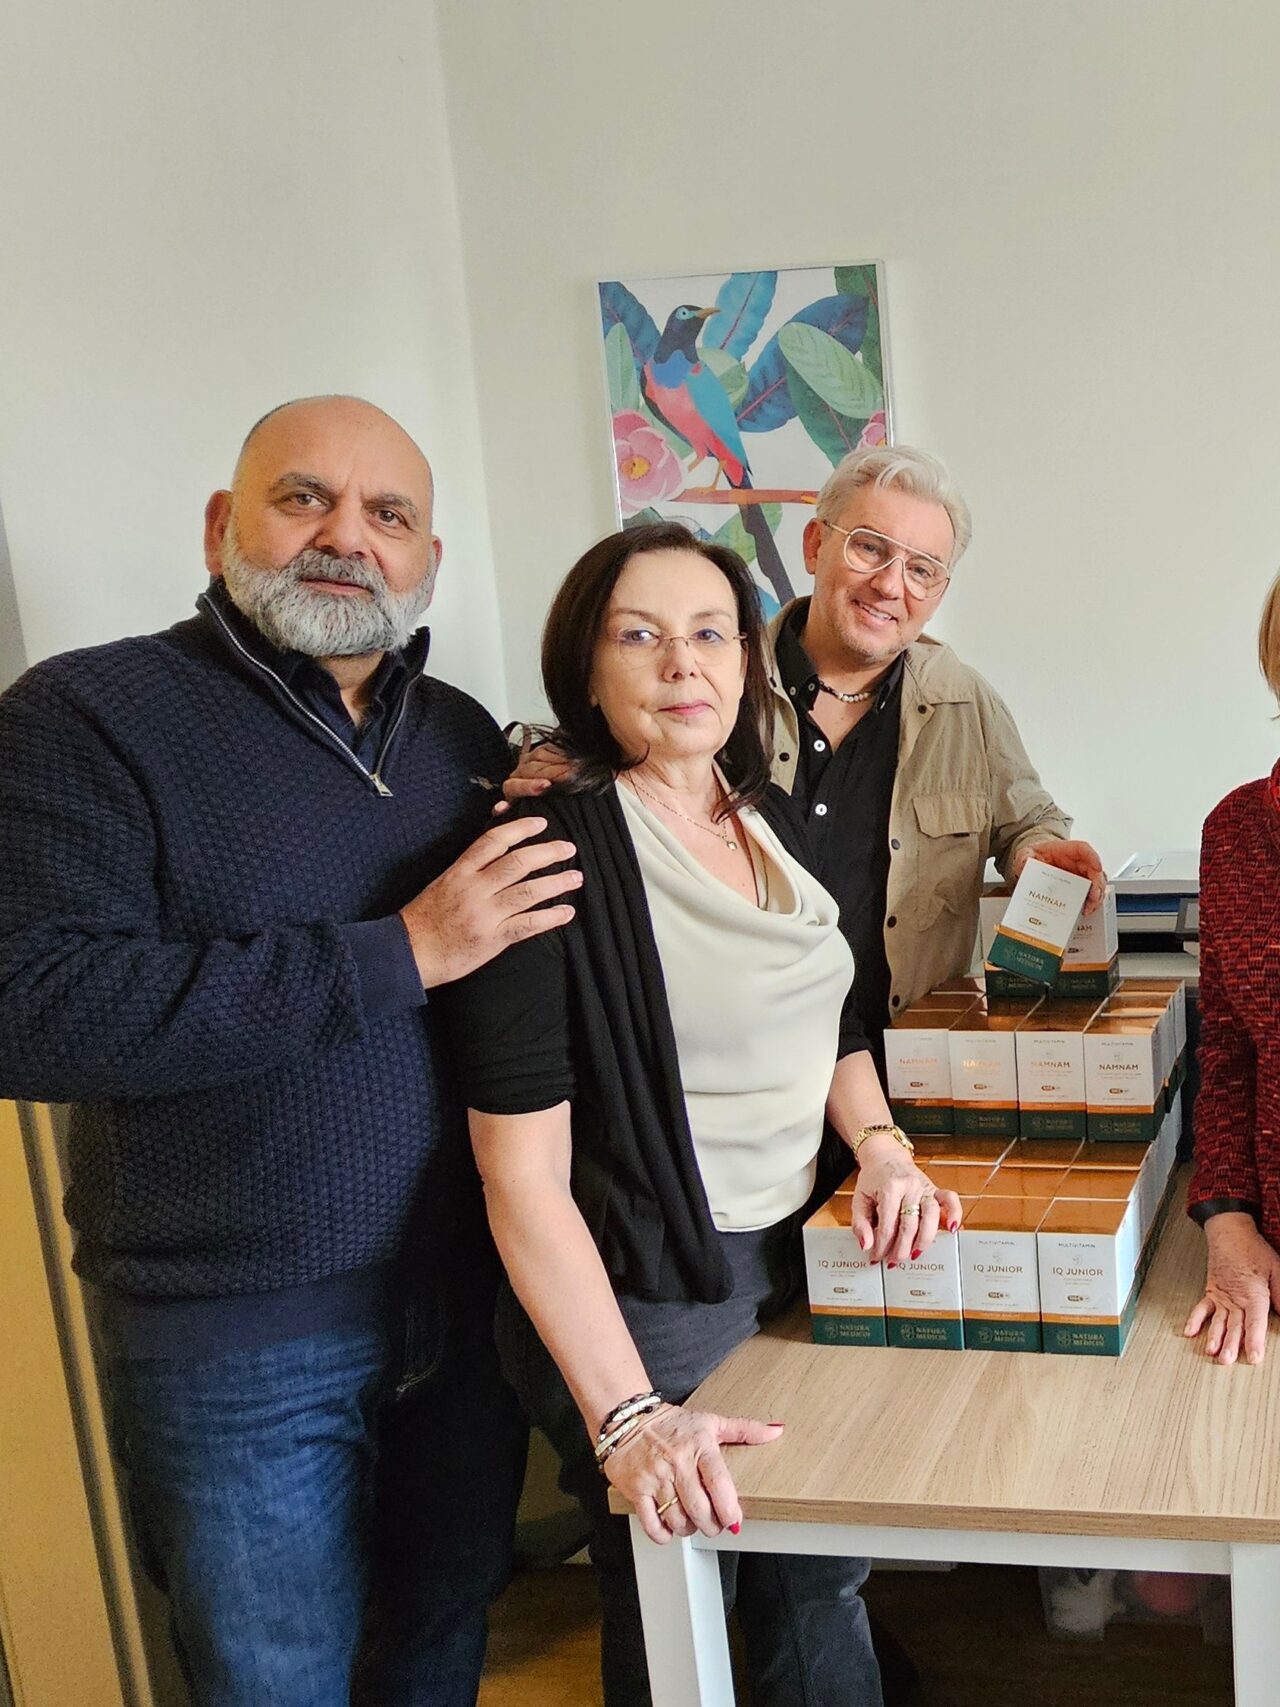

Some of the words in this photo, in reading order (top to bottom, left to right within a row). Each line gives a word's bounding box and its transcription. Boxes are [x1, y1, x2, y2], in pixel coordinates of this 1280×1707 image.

[1028, 890, 1067, 910] NAMNAM
[818, 1260, 829, 1268] IQ
[831, 1260, 867, 1268] JUNIOR
[909, 1262, 945, 1271] JUNIOR
[973, 1264, 984, 1273] IQ
[987, 1264, 1023, 1273] JUNIOR
[1052, 1267, 1063, 1276] IQ
[1066, 1267, 1104, 1276] JUNIOR
